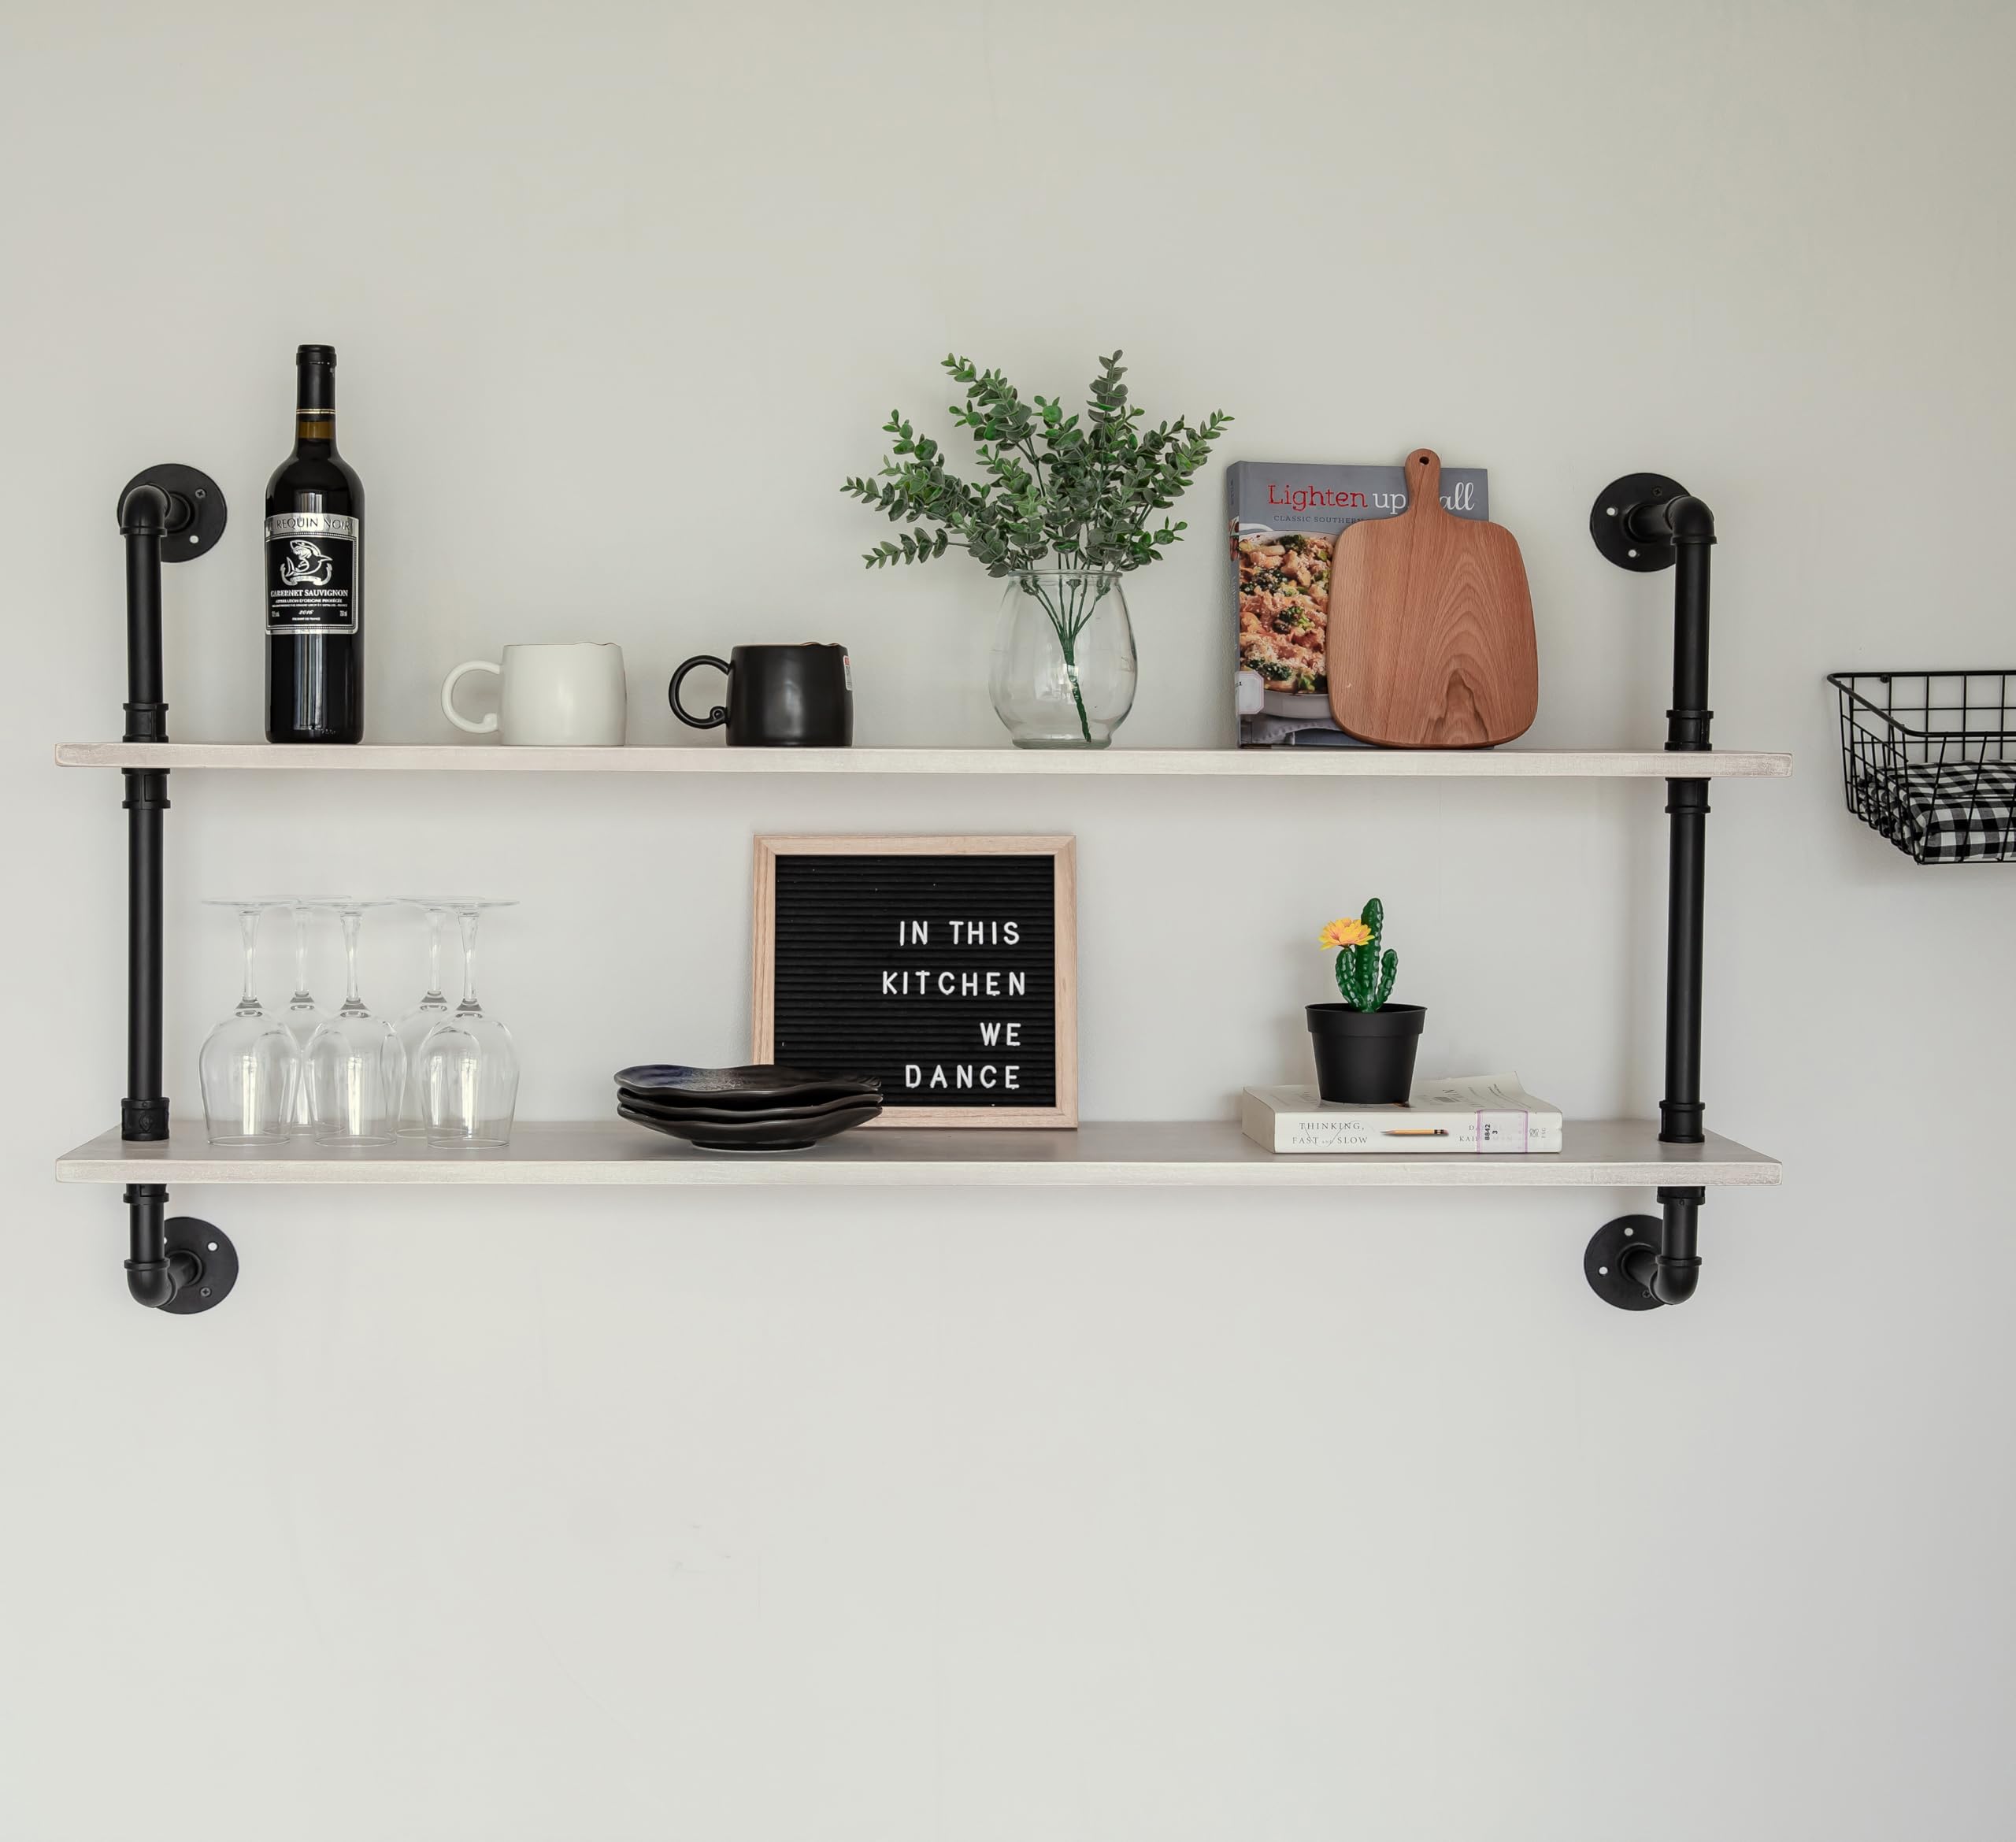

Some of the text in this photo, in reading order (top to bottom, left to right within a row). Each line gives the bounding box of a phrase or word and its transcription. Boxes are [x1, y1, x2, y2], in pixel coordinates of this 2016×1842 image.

[1267, 482, 1475, 514] Lighten up all
[276, 517, 318, 529] REQUIN
[899, 921, 1020, 946] IN THIS
[883, 970, 1025, 996] KITCHEN
[980, 1022, 1021, 1047] WE
[906, 1064, 1020, 1089] DANCE
